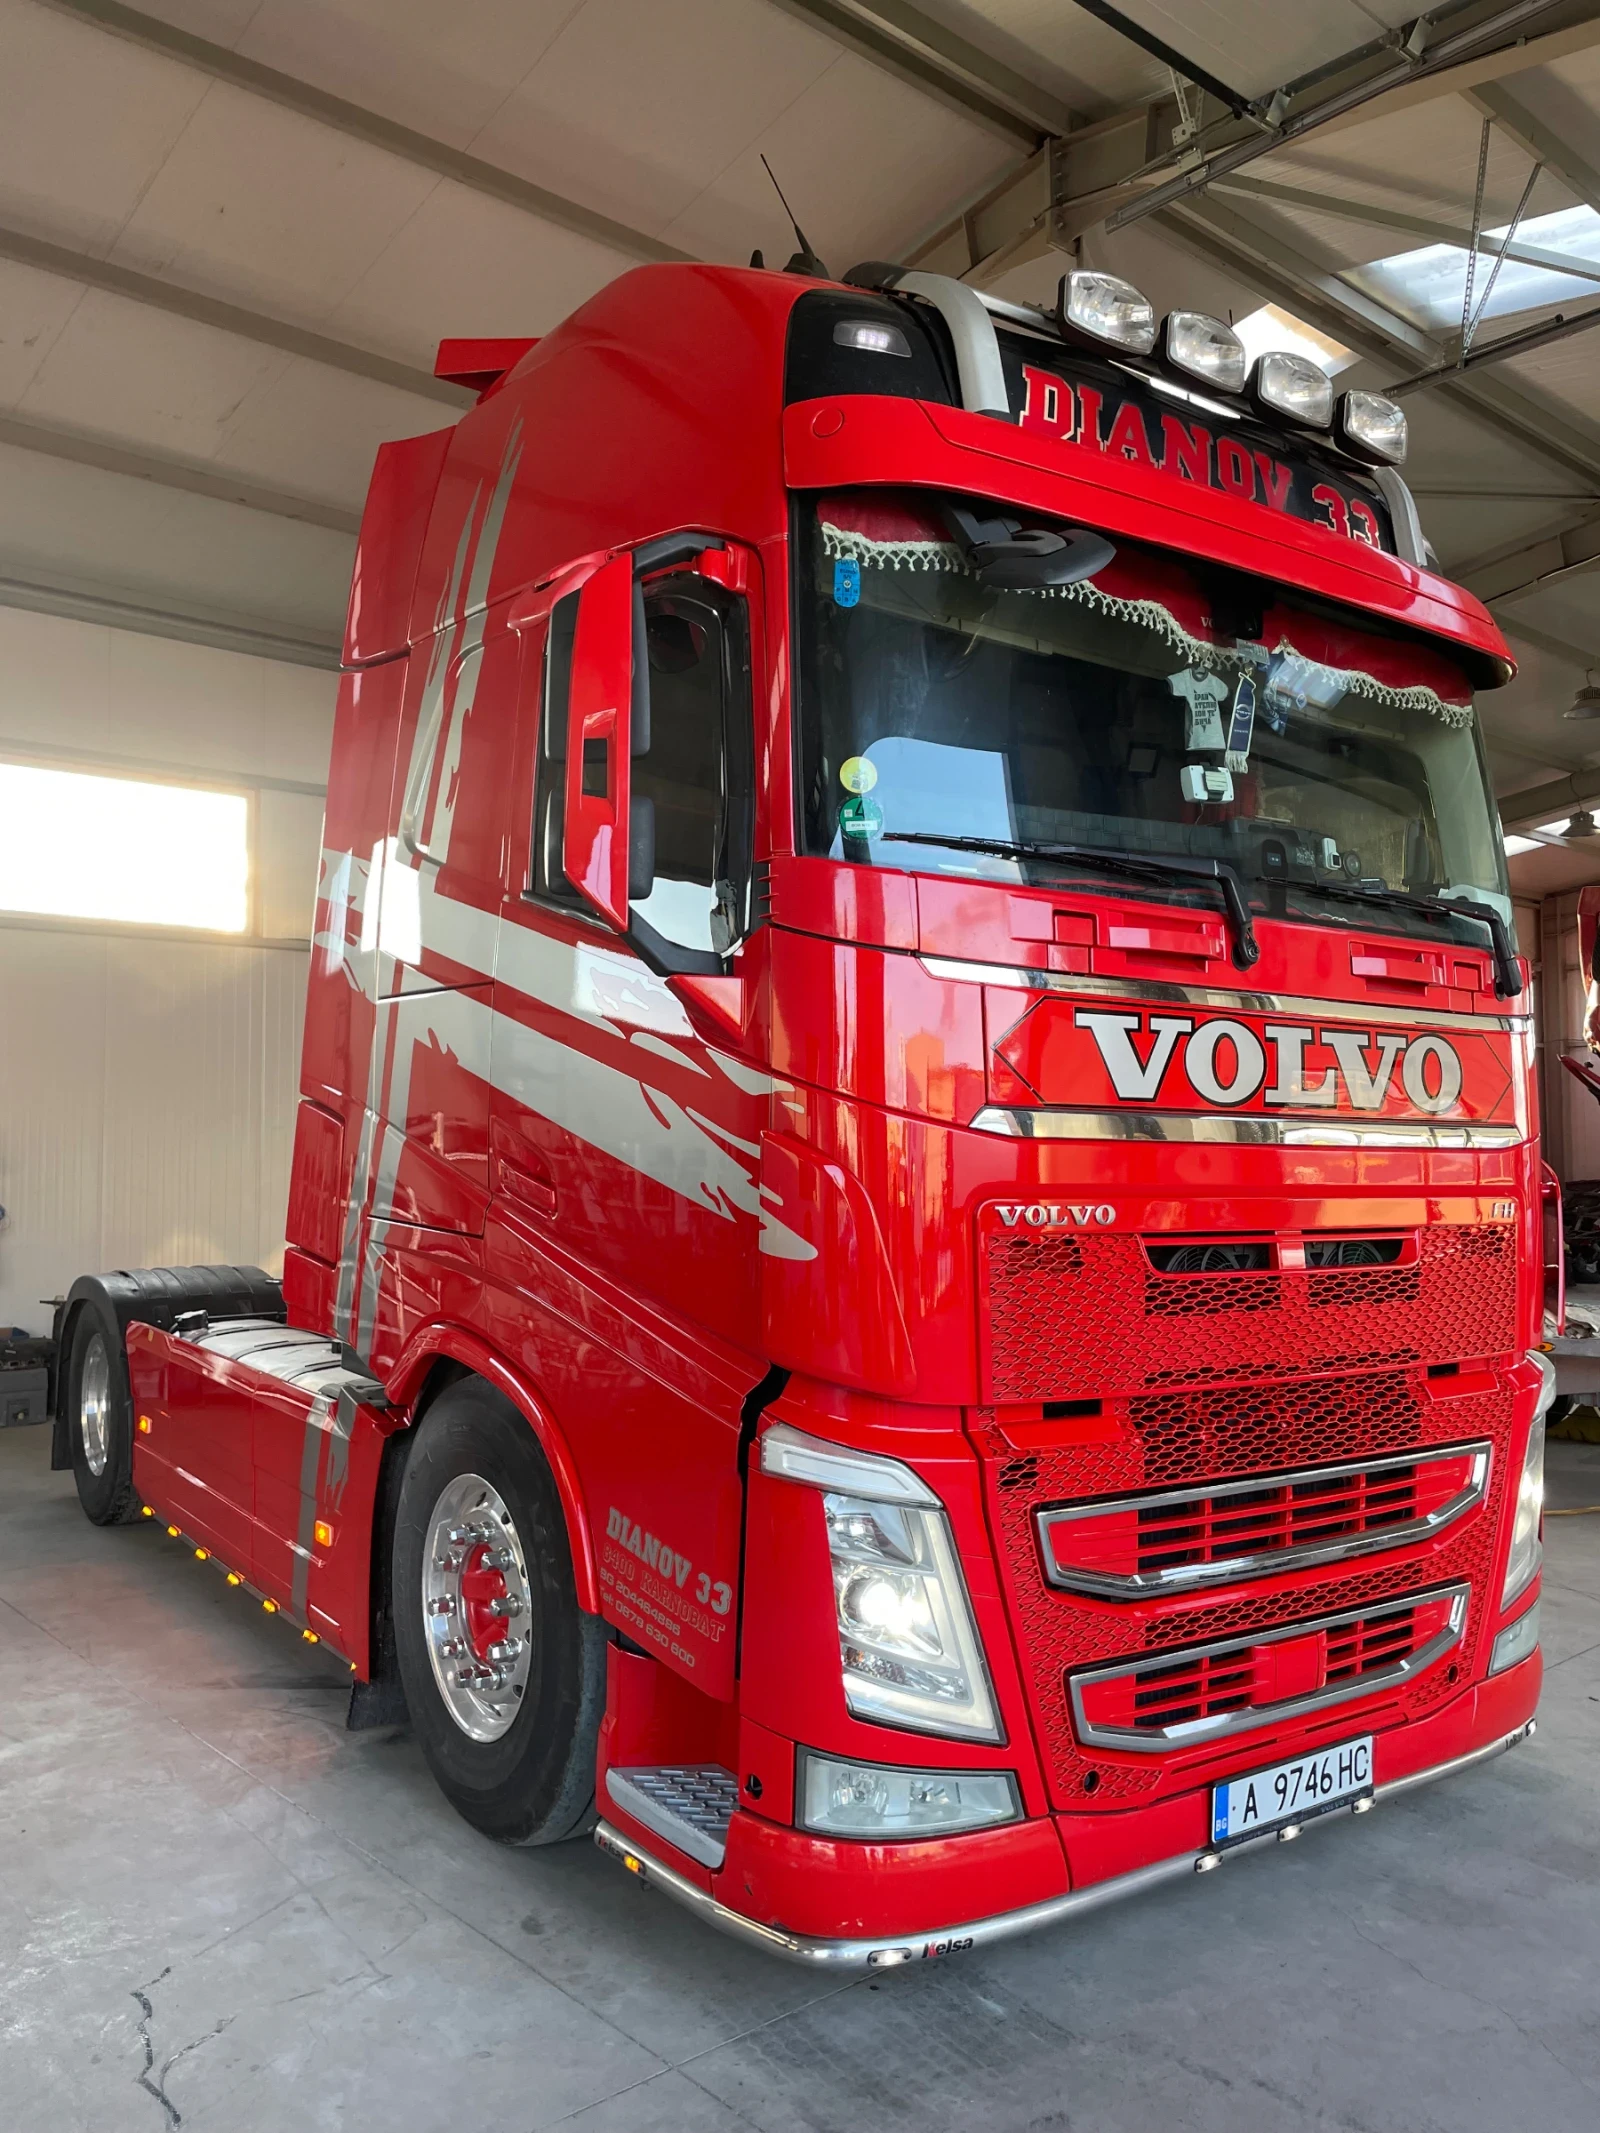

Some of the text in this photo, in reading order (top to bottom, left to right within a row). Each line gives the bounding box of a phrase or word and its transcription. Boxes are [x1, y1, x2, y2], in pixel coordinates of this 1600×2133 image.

[1019, 363, 1381, 550] DIANOV 33
[1074, 1006, 1463, 1115] VOLVO
[995, 1204, 1117, 1227] VOLVO
[1493, 1202, 1515, 1218] FH
[600, 1567, 614, 1586] BG
[606, 1505, 733, 1616] DIANOV 33
[615, 1600, 644, 1628] 0878
[646, 1624, 669, 1648] 630
[640, 1570, 726, 1643] KARNOBAT
[1243, 1744, 1368, 1824] A 9746 HC
[1215, 1817, 1228, 1833] BG
[921, 1937, 974, 1959] Kelsa
